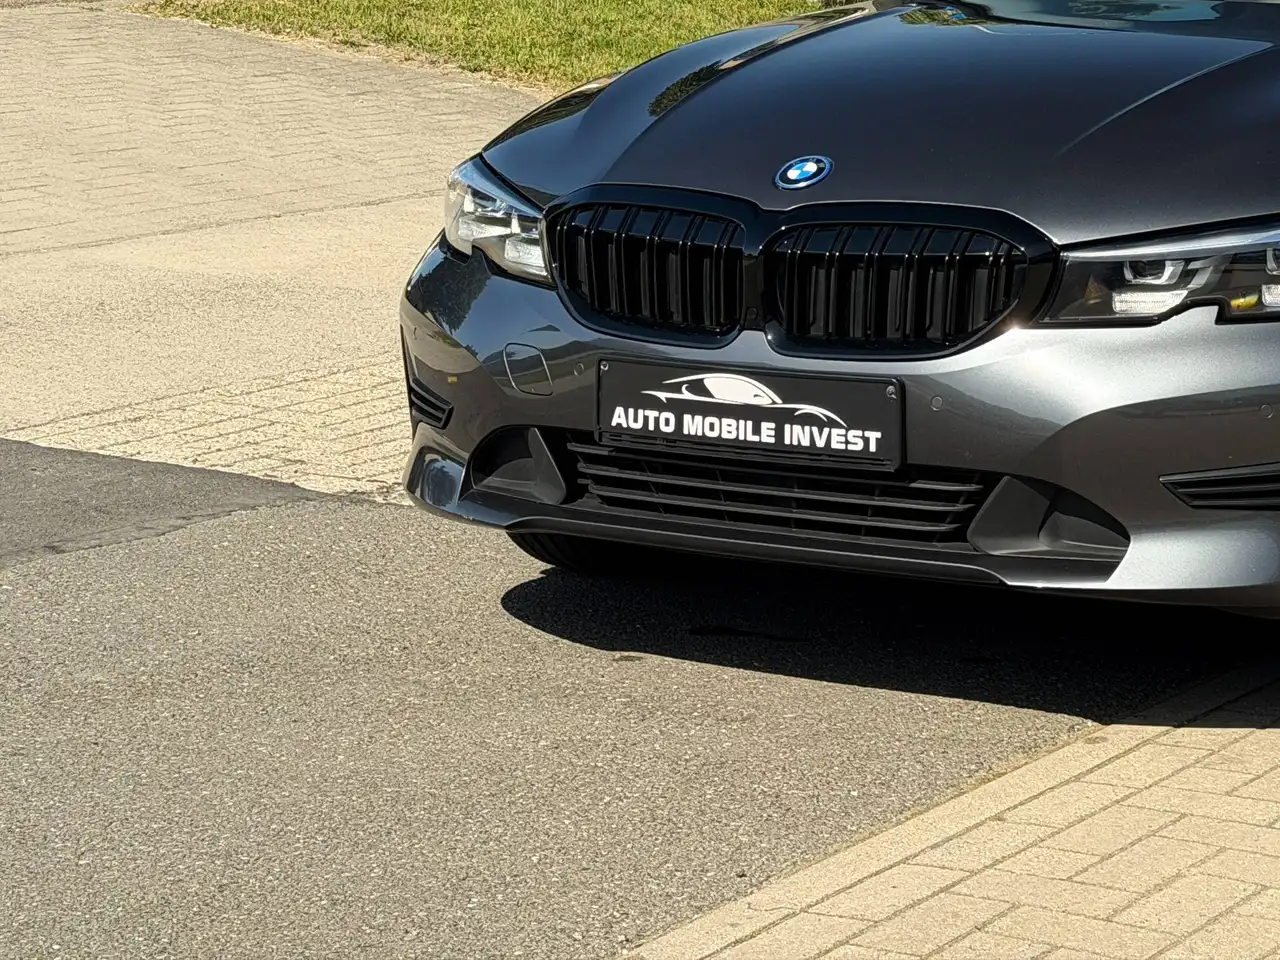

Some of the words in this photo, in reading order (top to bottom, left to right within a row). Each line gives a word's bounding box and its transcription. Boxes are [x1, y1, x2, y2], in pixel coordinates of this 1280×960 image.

[611, 406, 676, 433] AUTO
[682, 414, 776, 444] MOBILE
[783, 423, 882, 453] INVEST
